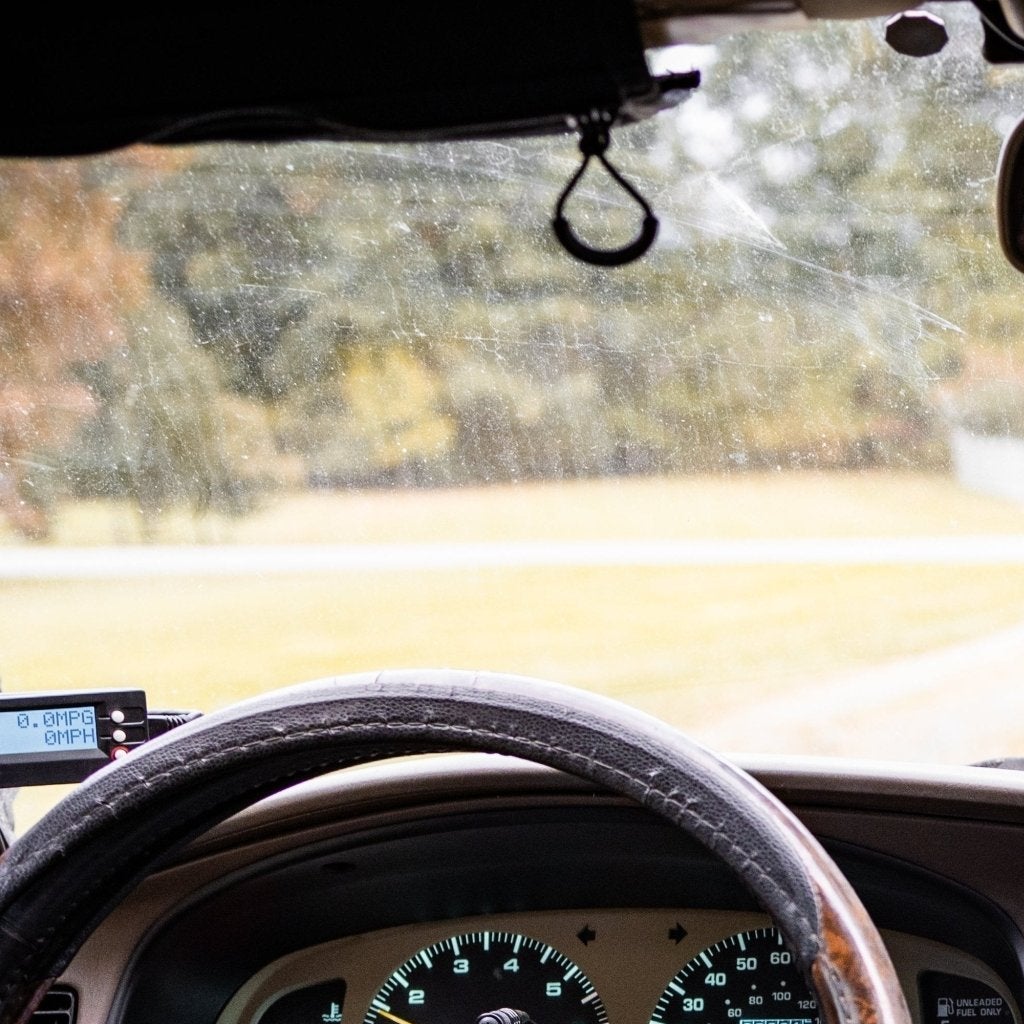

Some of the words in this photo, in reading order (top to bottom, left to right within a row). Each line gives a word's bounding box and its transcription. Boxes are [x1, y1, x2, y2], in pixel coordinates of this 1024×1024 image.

[18, 711, 93, 728] 0.0MPG
[45, 729, 95, 745] 0MPH
[503, 958, 520, 973] 4
[736, 957, 758, 971] 50
[770, 952, 791, 965] 60
[453, 958, 470, 974] 3
[704, 972, 727, 986] 40
[545, 982, 562, 997] 5
[771, 991, 791, 1001] 100
[408, 989, 425, 1005] 2
[748, 996, 763, 1005] 80
[956, 998, 1003, 1007] UNLEADED
[682, 998, 704, 1012] 30
[797, 1000, 817, 1009] 120
[727, 1008, 742, 1018] 60
[956, 1008, 977, 1017] FUEL
[980, 1008, 1002, 1016] ONLY
